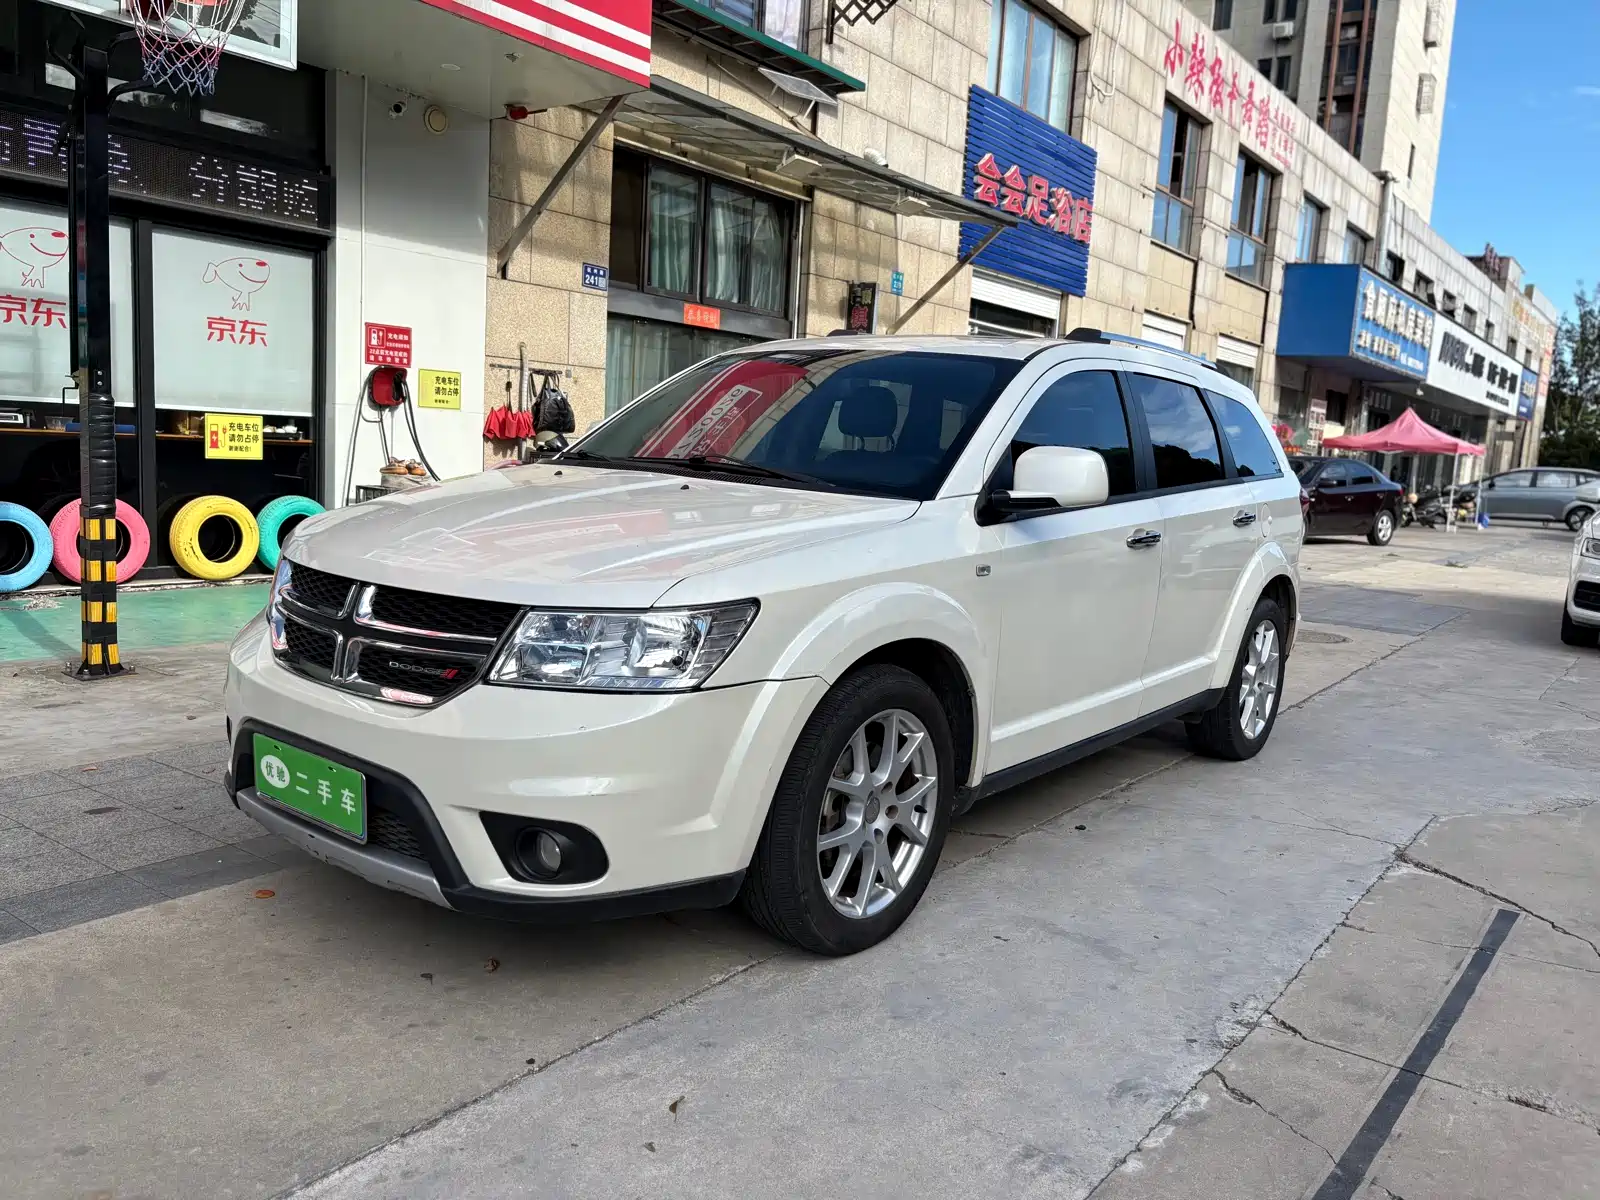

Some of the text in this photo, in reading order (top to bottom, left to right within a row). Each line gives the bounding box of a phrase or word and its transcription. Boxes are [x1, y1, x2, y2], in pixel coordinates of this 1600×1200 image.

[973, 152, 1093, 242] 会会足浴店
[585, 275, 598, 286] 241
[0, 294, 67, 329] 京东
[206, 316, 268, 347] 京东
[434, 375, 460, 386] 充电车位
[434, 386, 460, 397] 请勿占停
[228, 422, 260, 432] 充电车位
[228, 433, 260, 443] 请勿占停
[389, 661, 440, 676] DODGE
[295, 771, 356, 816] 二手车
